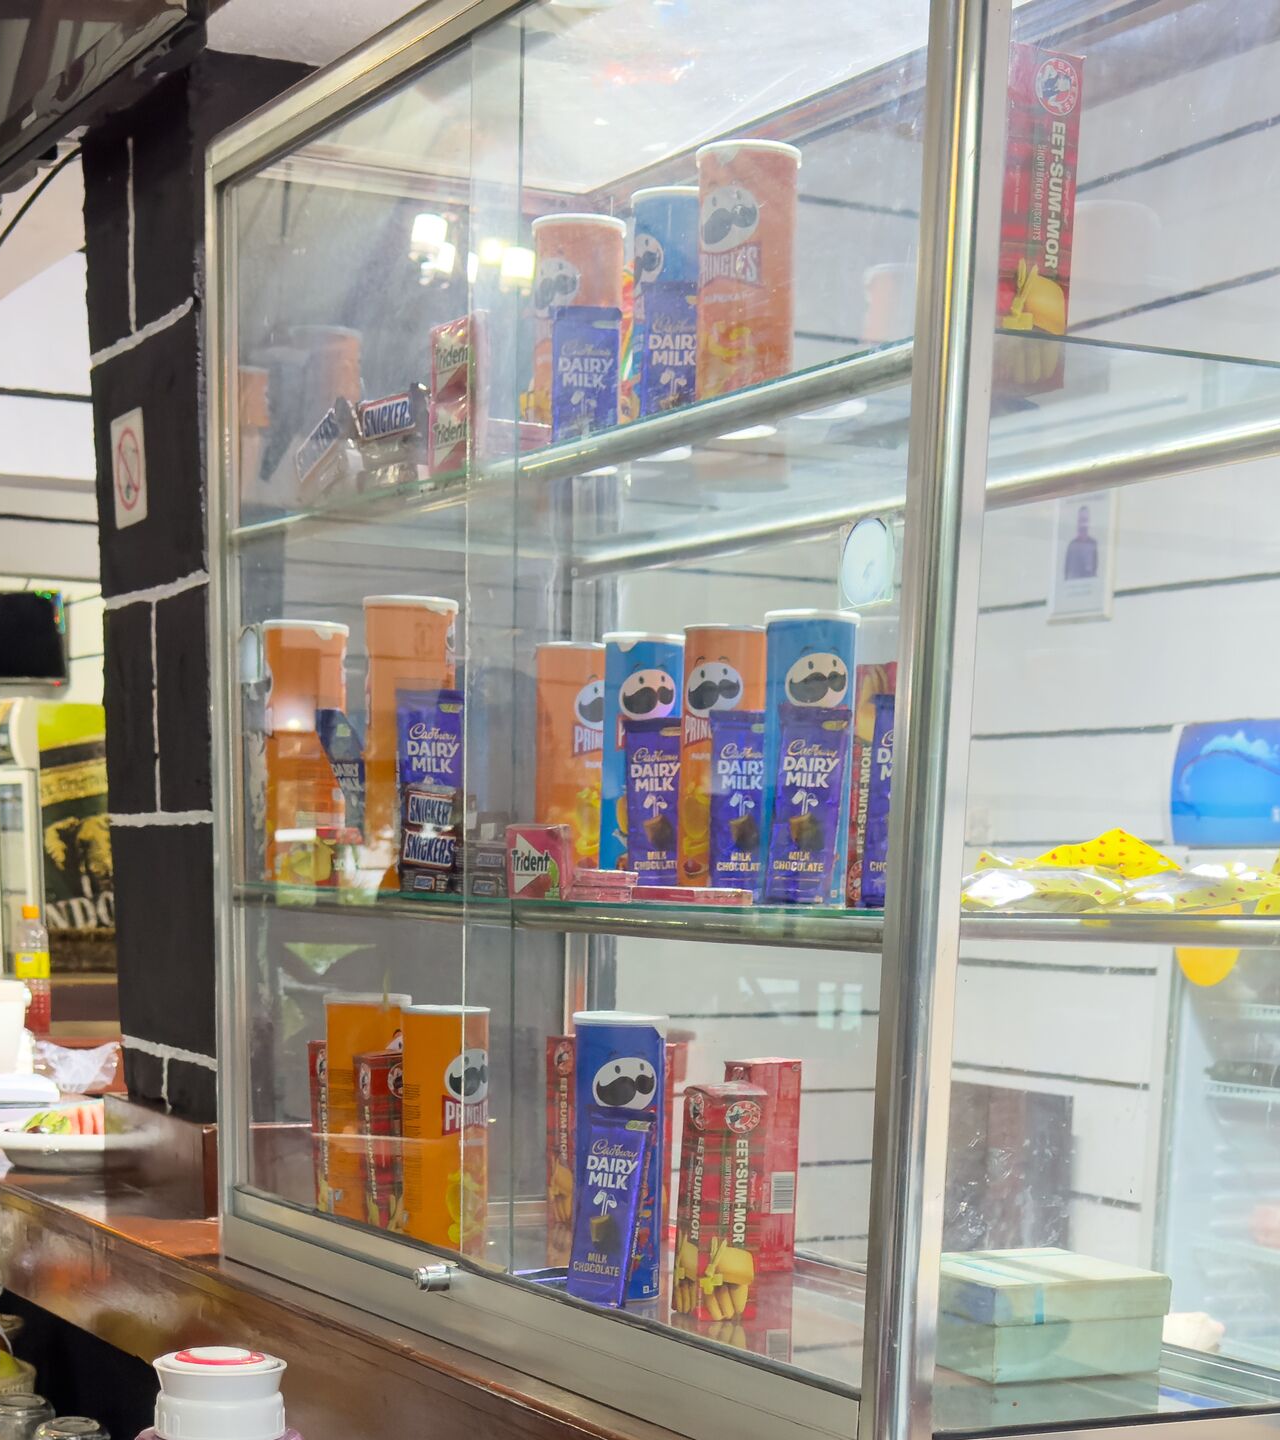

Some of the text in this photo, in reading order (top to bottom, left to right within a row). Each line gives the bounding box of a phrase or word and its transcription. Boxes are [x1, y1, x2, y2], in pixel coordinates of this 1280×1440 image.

[1044, 120, 1066, 268] EET-SUM-MOR
[558, 357, 614, 373] DAIRY
[652, 350, 696, 366] MILK
[562, 372, 606, 389] MILK
[409, 722, 457, 742] Cadbury
[574, 726, 603, 752] PRIN
[407, 740, 460, 757] DAIRY
[412, 757, 454, 774] MILK
[631, 762, 681, 778] DAIRY
[783, 756, 840, 772] DAIRY
[635, 777, 675, 792] MILK
[721, 775, 763, 790] MILK
[785, 772, 830, 788] MILK
[409, 796, 453, 825] SNICKER
[405, 833, 456, 866] SNICKERS
[731, 852, 752, 861] MILK
[789, 852, 810, 861] MILK
[511, 850, 550, 873] Trident
[716, 862, 760, 872] CHOCOLAT
[773, 861, 824, 872] CHOCOLATE
[591, 1138, 639, 1158] Cadbury
[586, 1155, 639, 1174] DAIRY
[588, 1171, 628, 1190] MILK
[687, 1136, 705, 1240] EET-SUM-MOR
[732, 1139, 749, 1243] EET-SUM-MOR
[587, 1252, 608, 1263] MILK
[573, 1261, 621, 1277] CHOCOLATE
